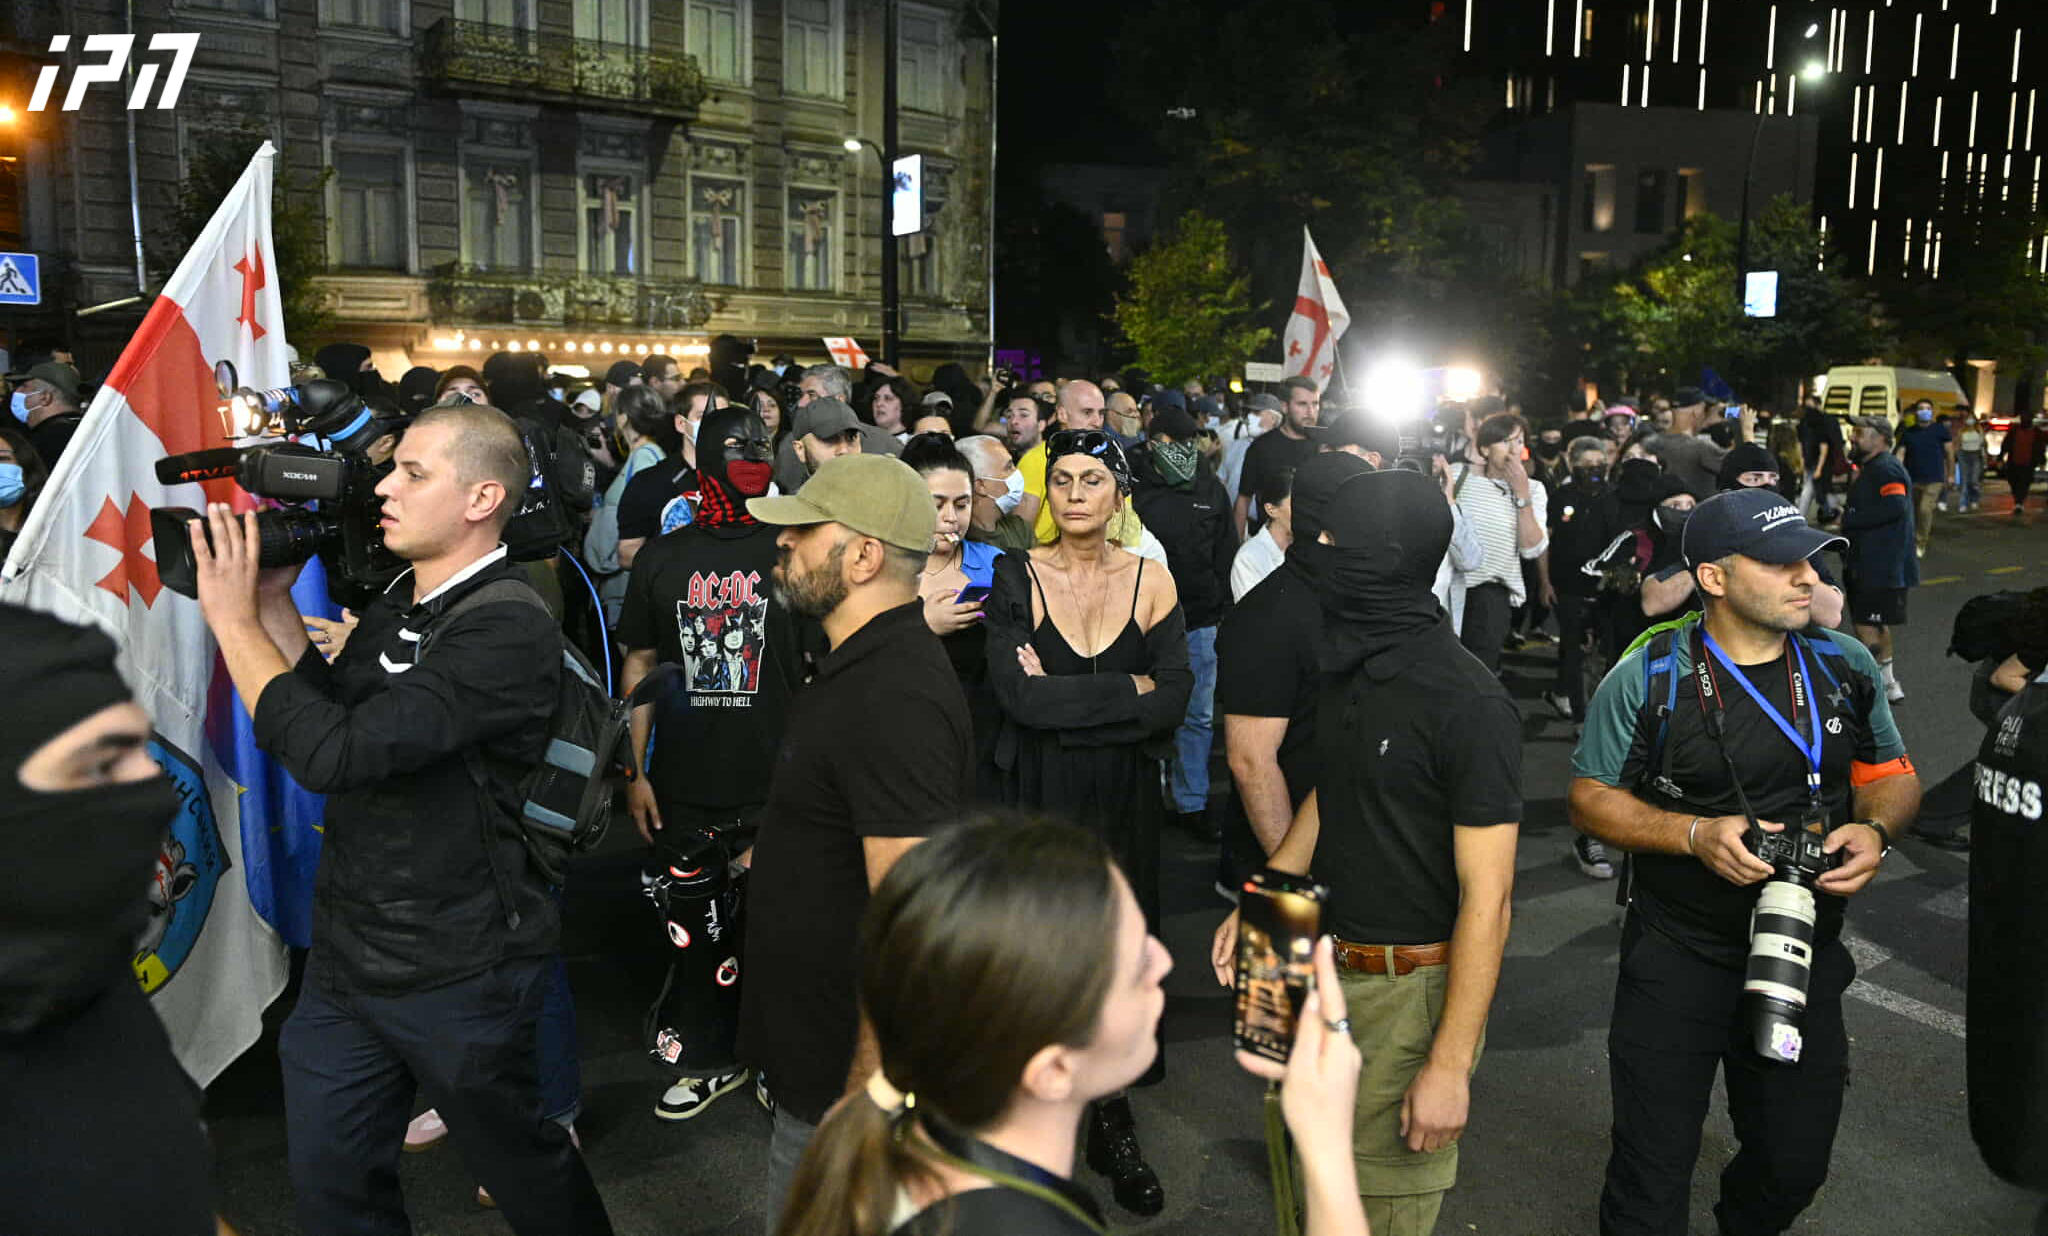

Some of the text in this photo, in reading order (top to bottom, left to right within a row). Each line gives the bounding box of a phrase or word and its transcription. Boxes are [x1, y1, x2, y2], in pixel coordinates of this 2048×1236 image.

[1700, 674, 1713, 697] EOS
[1793, 672, 1805, 707] Canon
[722, 696, 732, 707] TO
[733, 696, 752, 707] HELL
